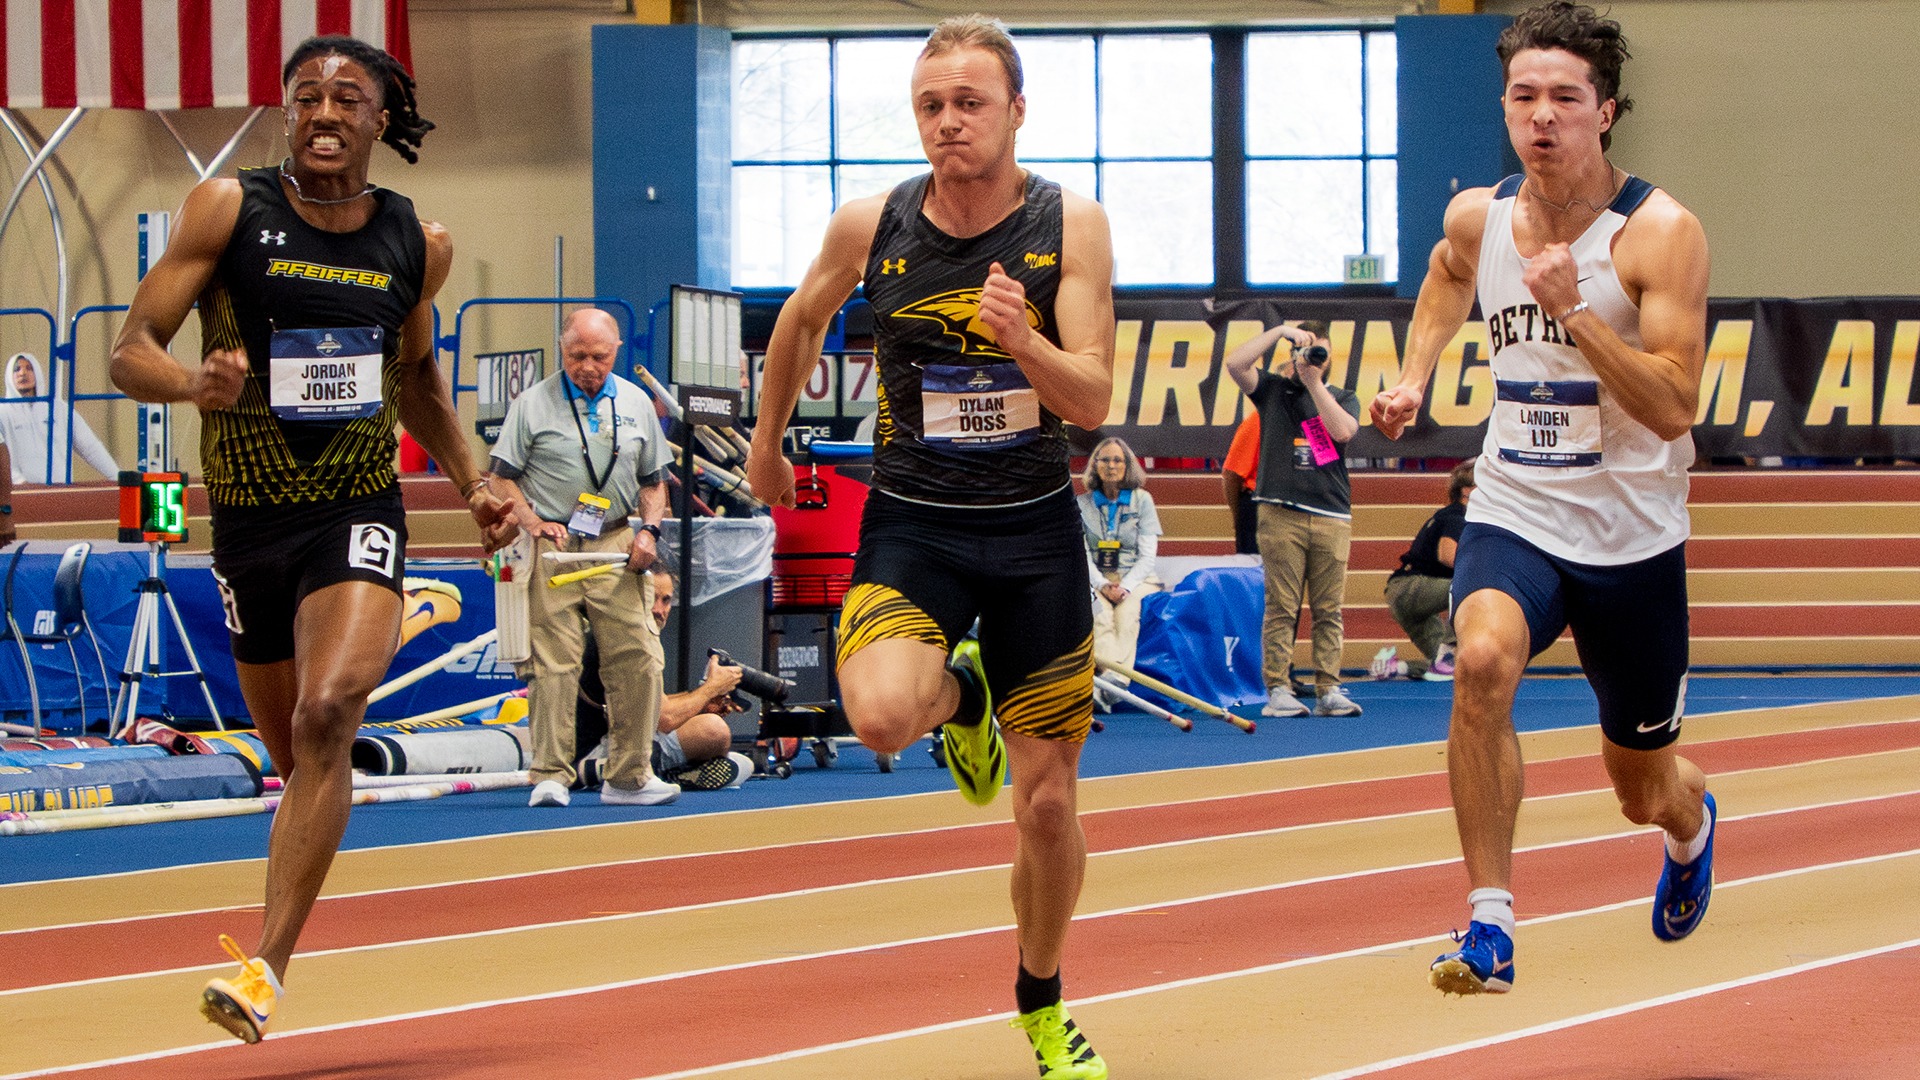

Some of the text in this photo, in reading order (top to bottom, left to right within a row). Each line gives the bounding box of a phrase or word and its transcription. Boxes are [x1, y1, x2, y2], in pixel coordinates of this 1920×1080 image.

[267, 259, 391, 291] PFEIFFER
[1350, 259, 1378, 279] EXIT
[1489, 304, 1577, 356] BETH
[301, 363, 356, 379] JORDAN
[301, 381, 357, 401] JONES
[959, 397, 1005, 413] DYLAN
[960, 413, 1007, 432] DOSS
[1520, 409, 1570, 427] LANDEN
[1531, 429, 1558, 448] LIU
[149, 482, 184, 533] 75
